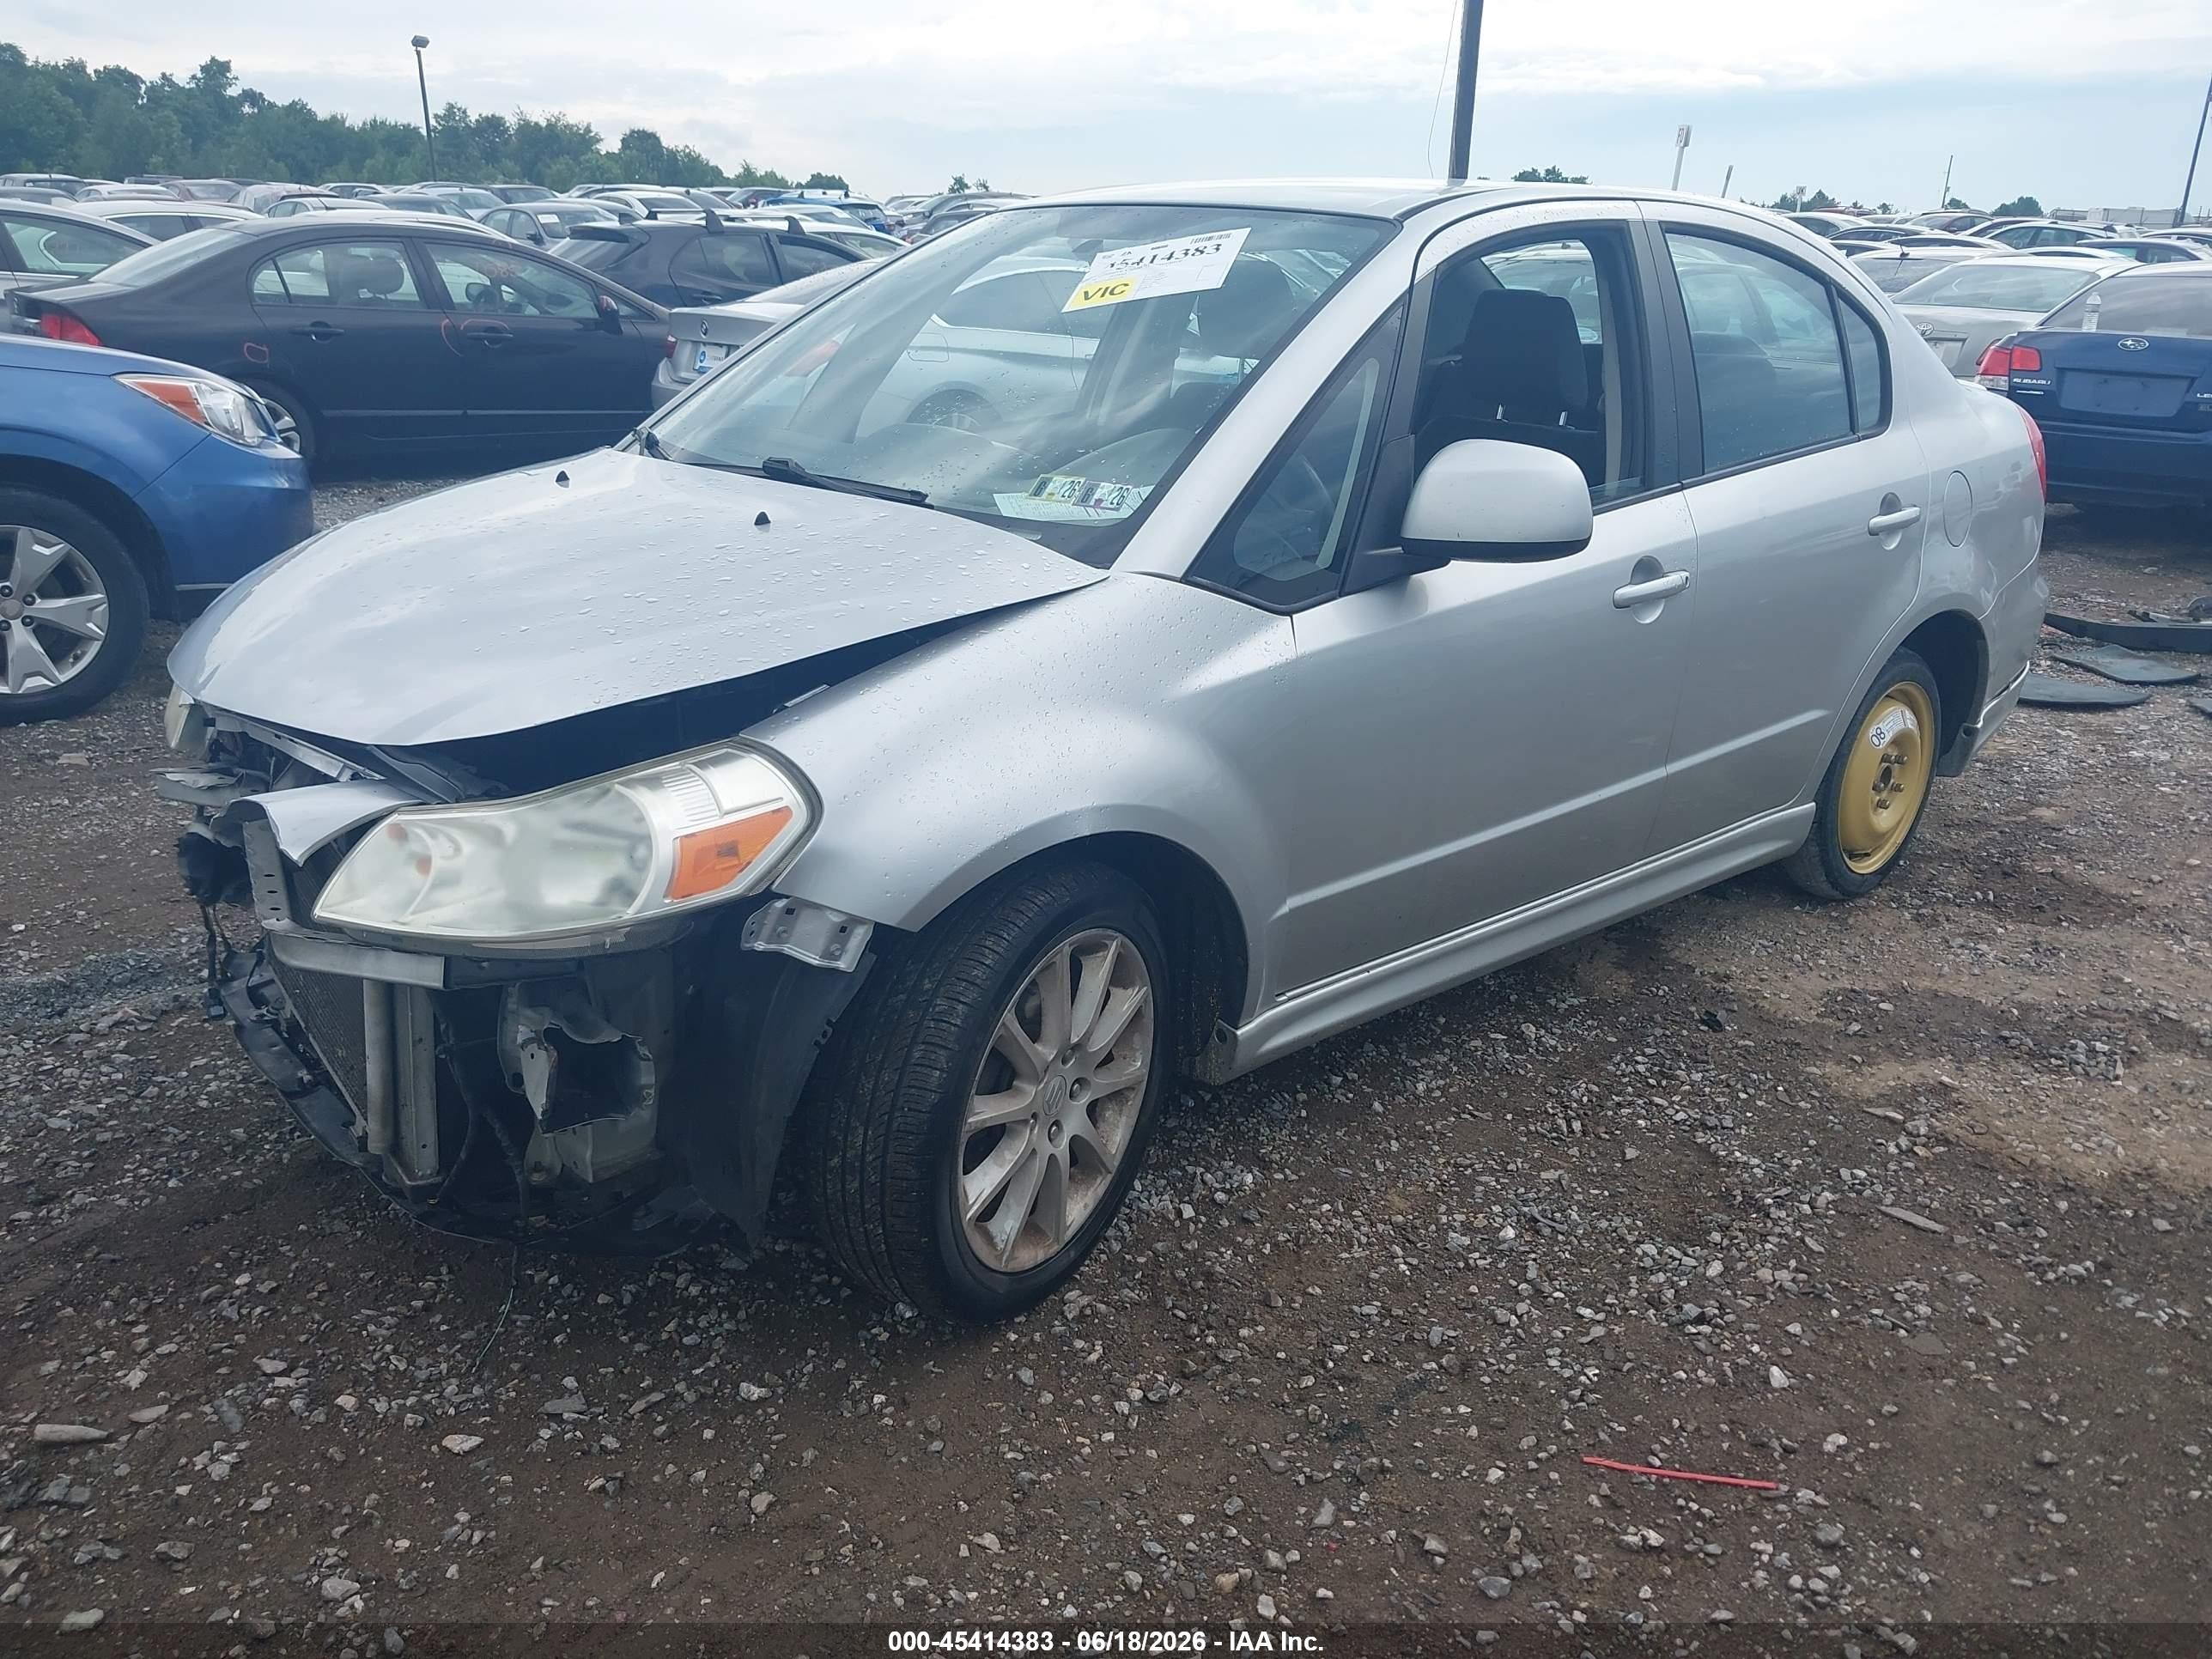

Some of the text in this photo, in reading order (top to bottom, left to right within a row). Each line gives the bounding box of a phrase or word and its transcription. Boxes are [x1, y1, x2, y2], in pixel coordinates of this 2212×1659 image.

[1084, 283, 1130, 301] VIC
[1033, 480, 1048, 496] 6
[1080, 487, 1094, 503] 6
